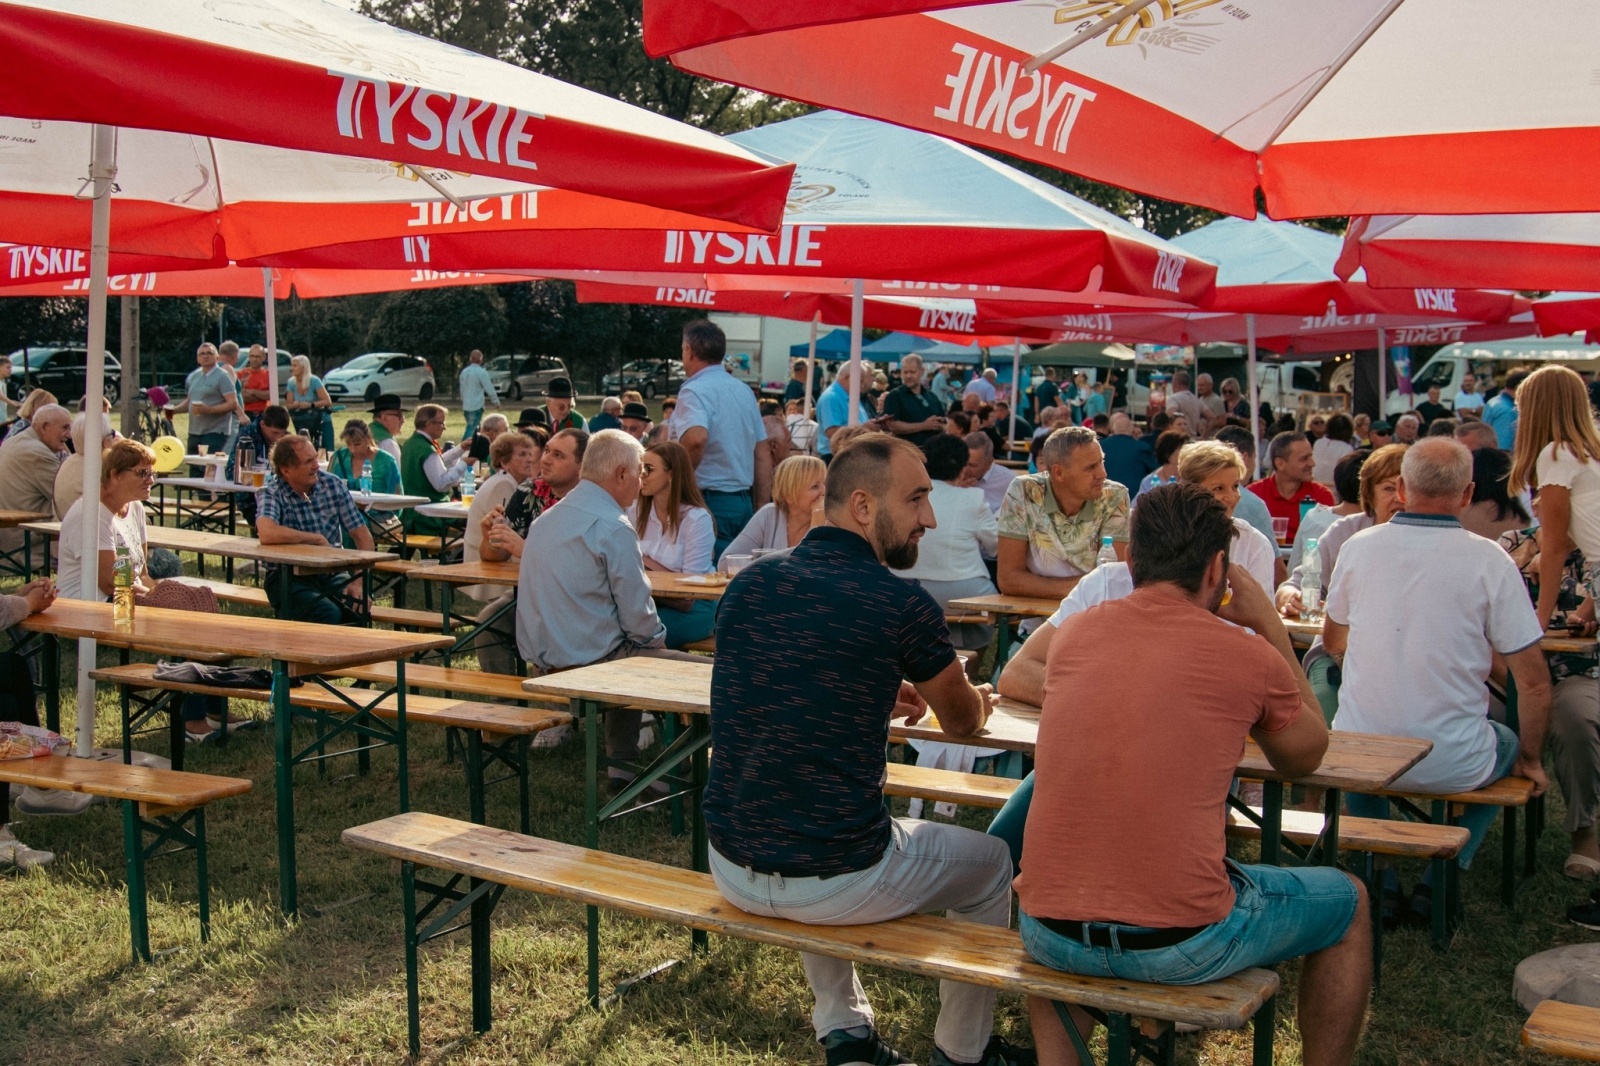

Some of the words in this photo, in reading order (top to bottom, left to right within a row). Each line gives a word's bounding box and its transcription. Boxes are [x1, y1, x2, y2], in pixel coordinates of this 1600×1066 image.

[326, 68, 546, 170] TYSKIE
[8, 246, 86, 279] TYSKIE
[664, 226, 827, 266] TYSKIE
[1152, 249, 1187, 294] TYSKIE
[1414, 288, 1457, 312] TYSKIE
[919, 307, 976, 333] TYSKIE
